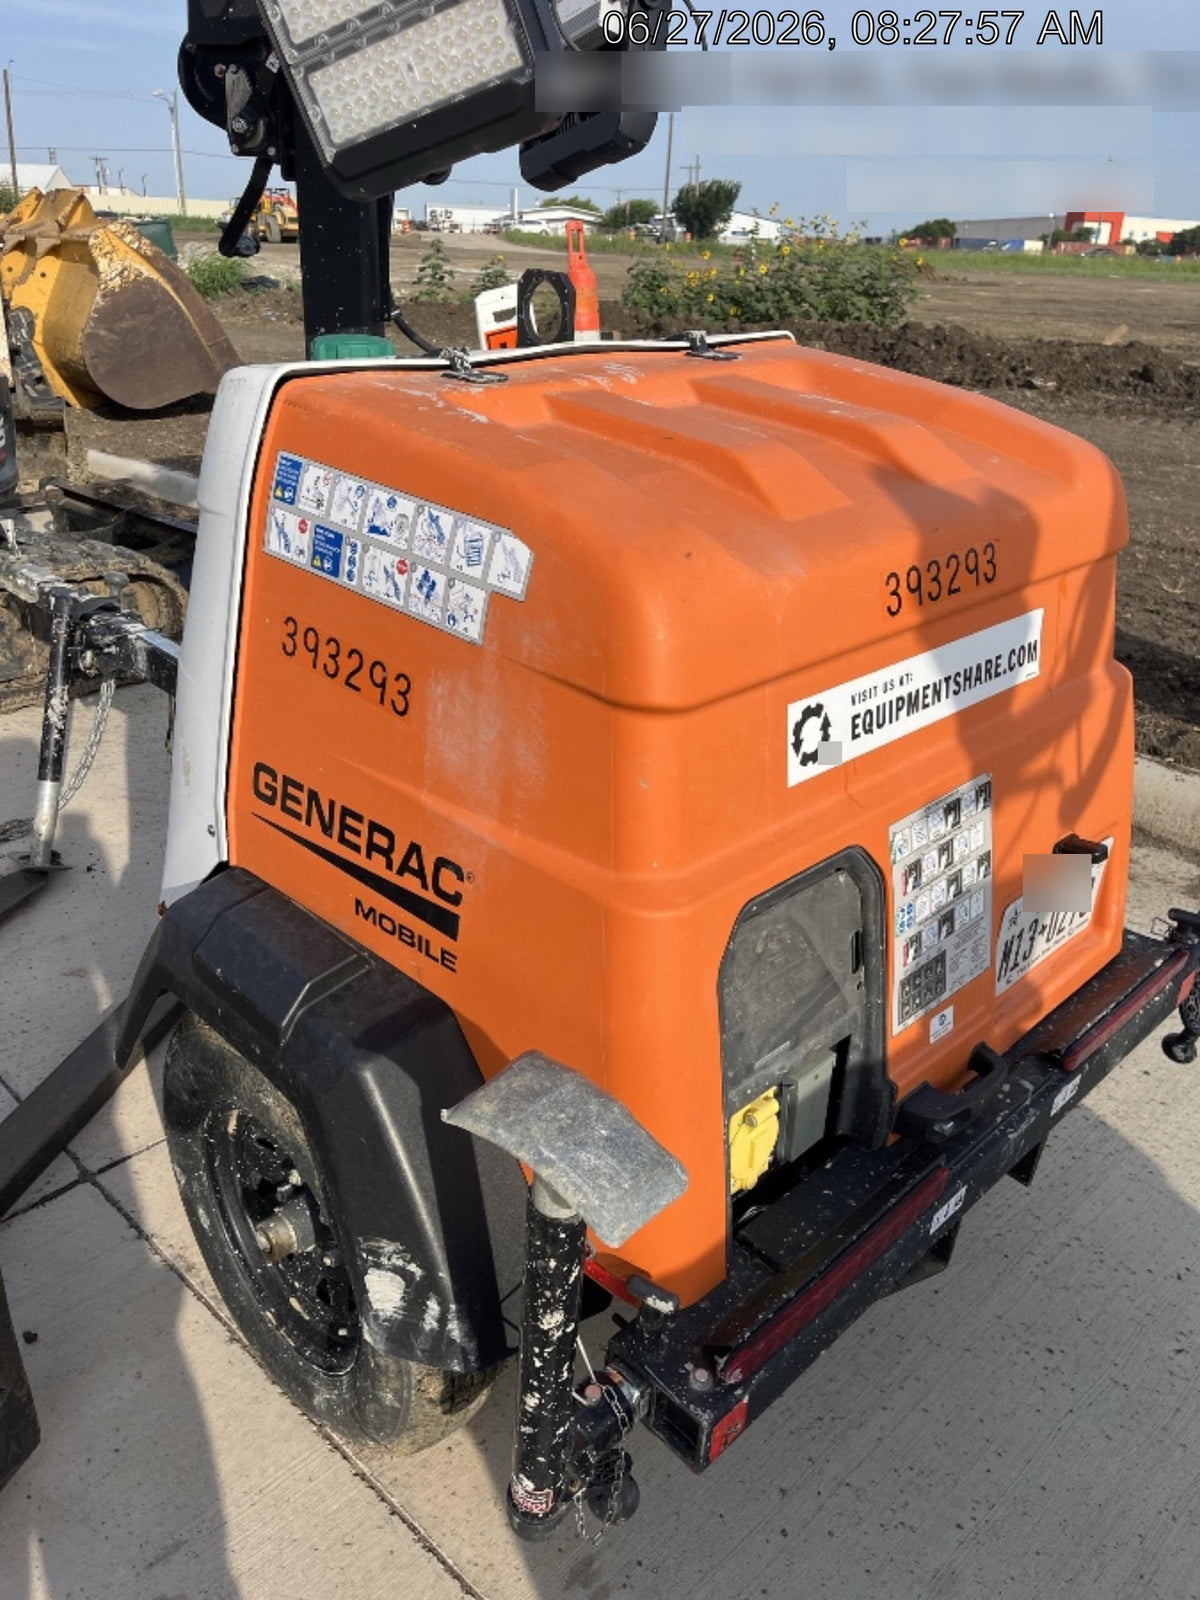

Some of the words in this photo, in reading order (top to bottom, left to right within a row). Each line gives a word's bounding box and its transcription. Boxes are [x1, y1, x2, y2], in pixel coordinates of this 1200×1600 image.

[885, 541, 997, 617] 393293
[281, 616, 413, 718] 393293
[850, 638, 1038, 741] EQUIPMENTSHARE.COM
[850, 685, 879, 707] VISIT
[882, 678, 895, 695] US
[252, 761, 465, 908] GENERAC
[354, 897, 459, 973] MOBILE
